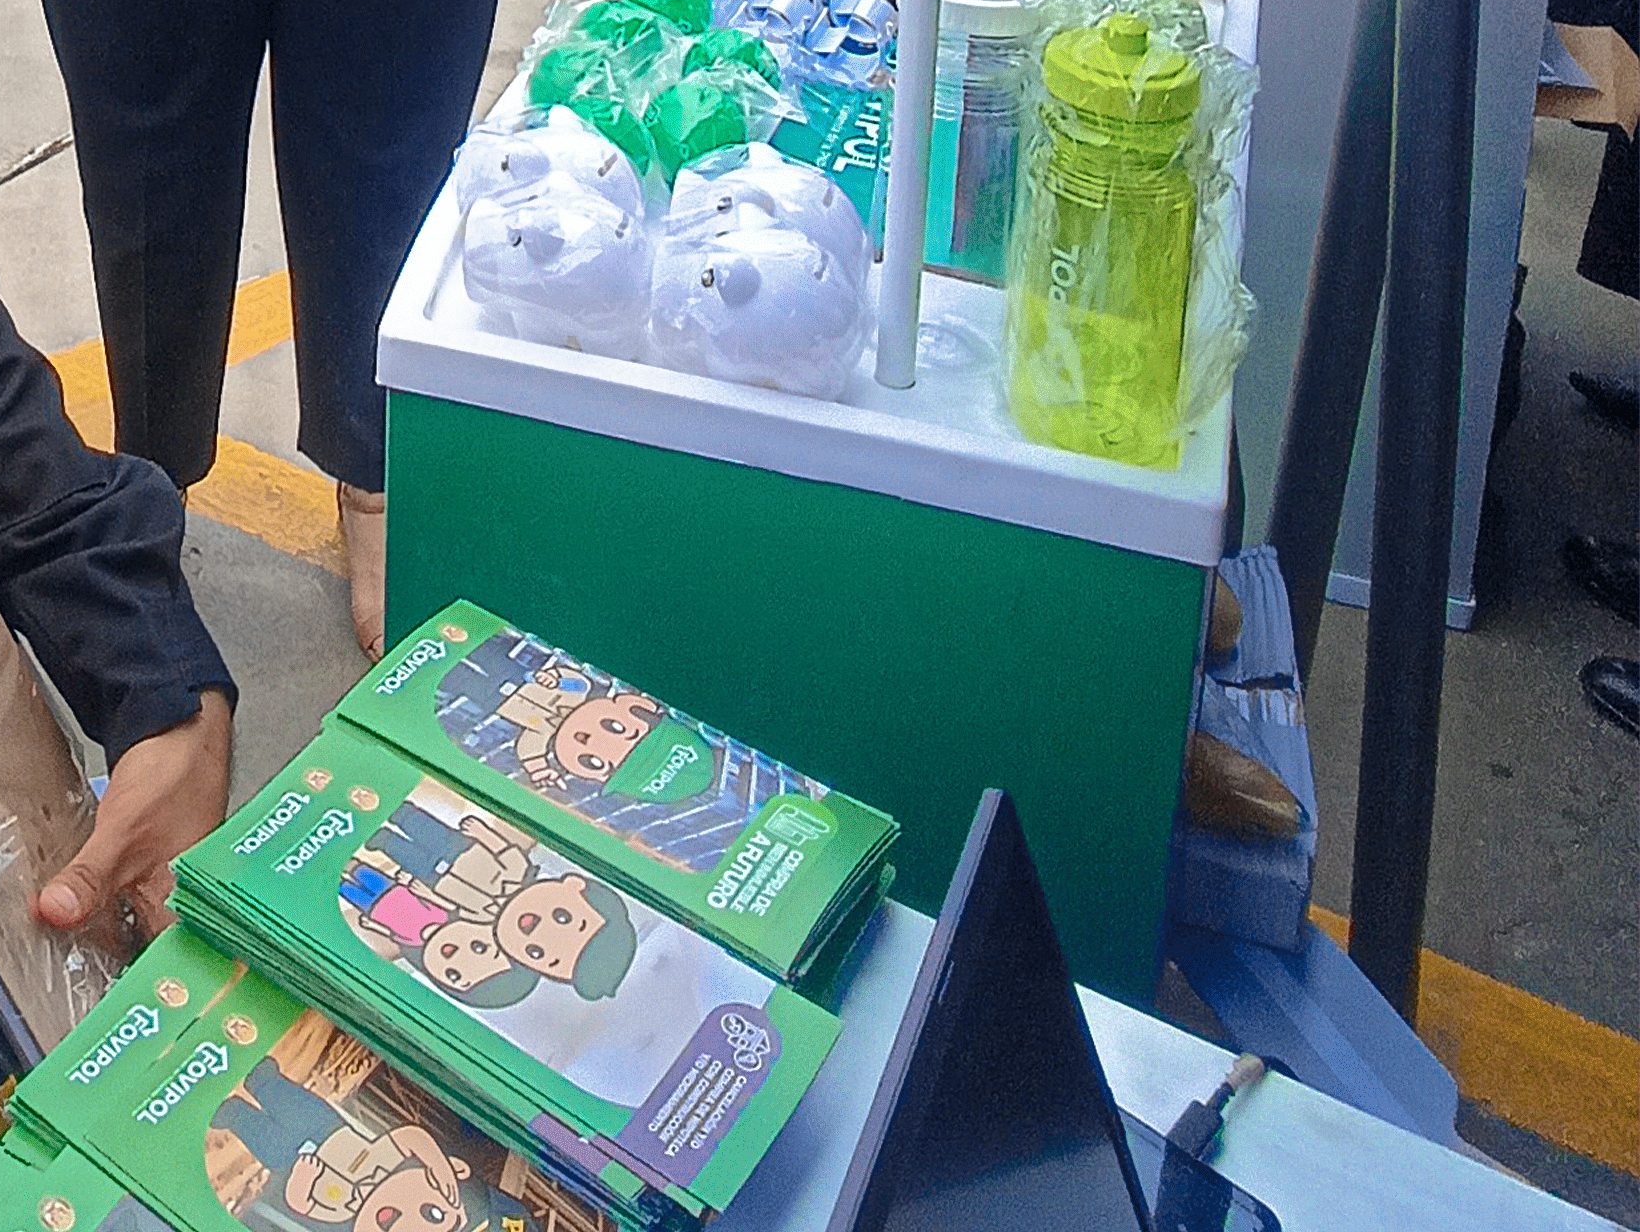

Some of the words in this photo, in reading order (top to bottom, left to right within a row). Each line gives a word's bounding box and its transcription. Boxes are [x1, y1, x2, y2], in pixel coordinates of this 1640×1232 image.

[375, 638, 450, 696] FOVIPOL
[641, 744, 700, 797] FOVIPOL
[233, 792, 309, 855] FOVIPOL
[274, 806, 353, 875] FOVIPOL
[749, 831, 771, 846] A
[707, 843, 764, 908] FUTURO
[749, 895, 772, 917] DE
[67, 1004, 160, 1085] FOVIPOL
[135, 1040, 230, 1124] FOVIPOL
